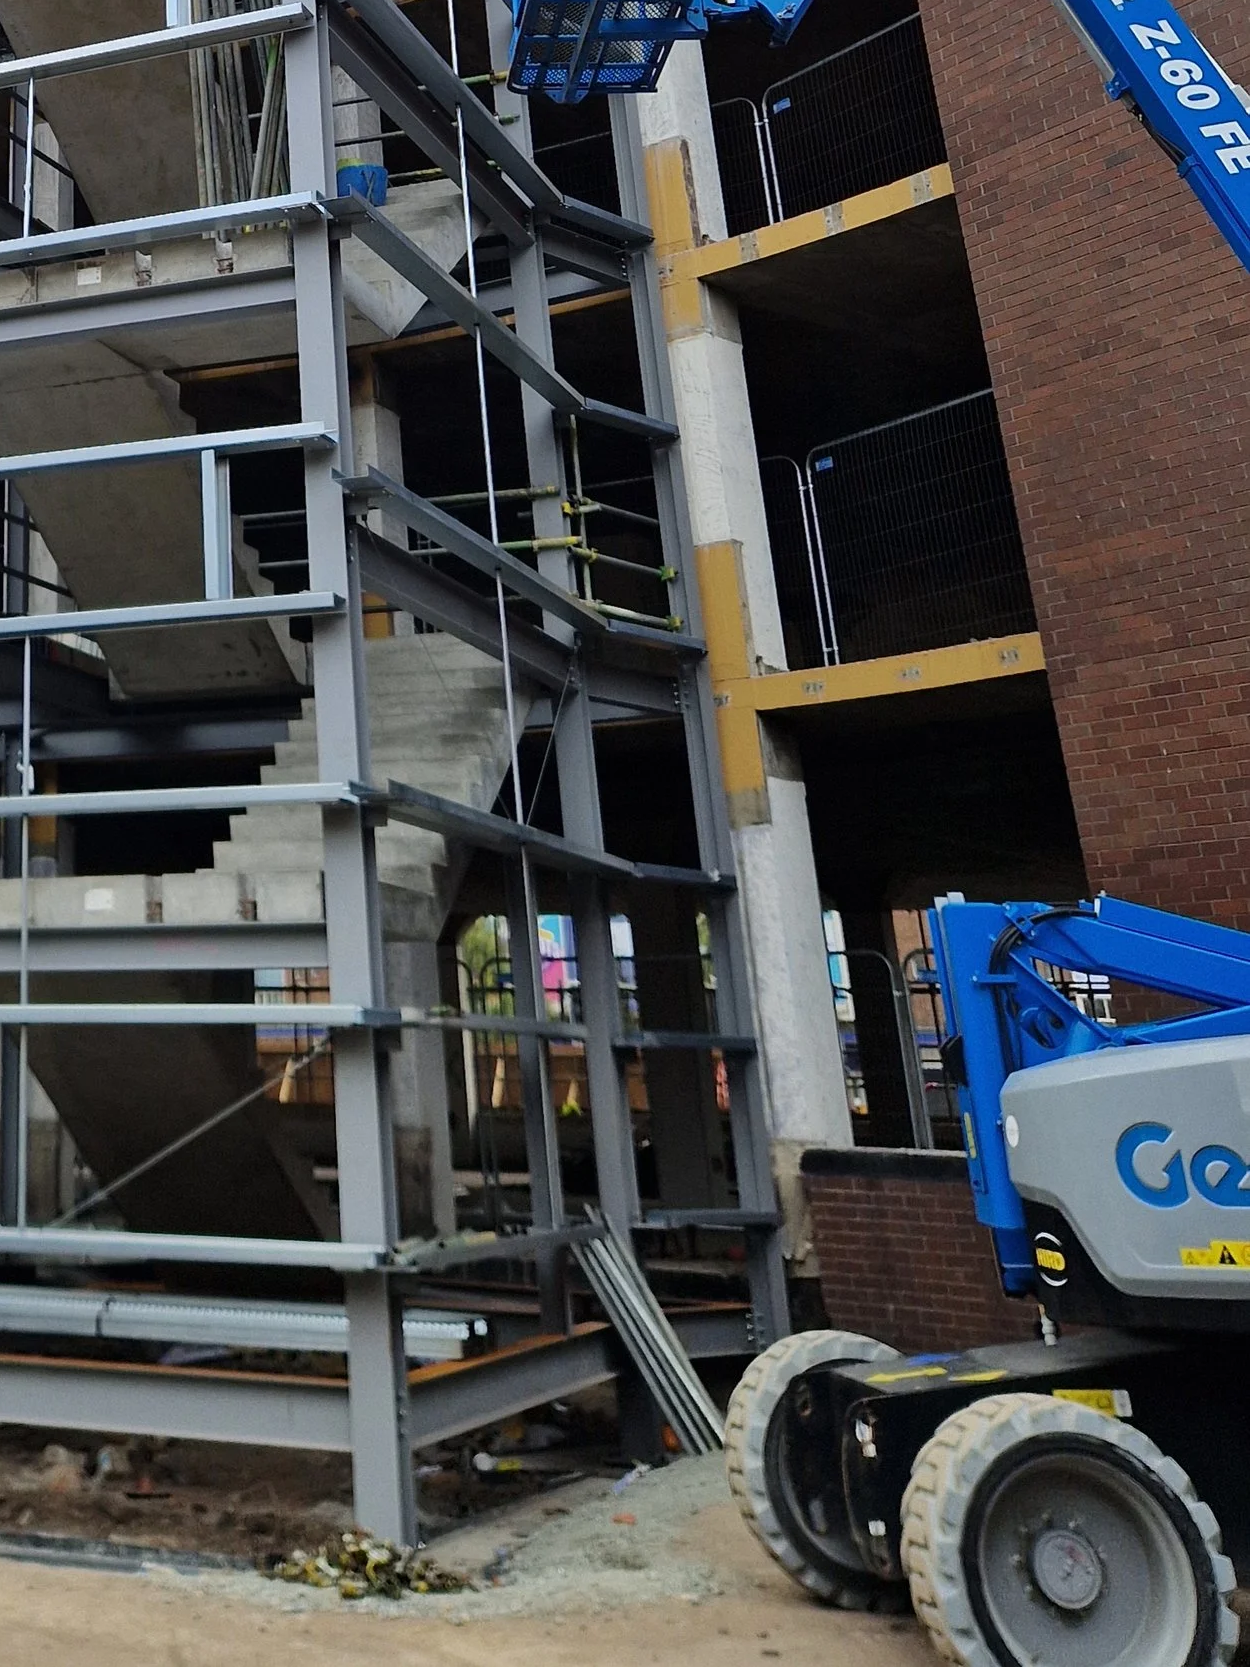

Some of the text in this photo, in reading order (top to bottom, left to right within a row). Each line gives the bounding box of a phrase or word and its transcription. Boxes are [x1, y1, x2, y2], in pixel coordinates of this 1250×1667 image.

[1129, 19, 1220, 110] Z-60
[1199, 121, 1250, 174] FE
[1115, 1121, 1250, 1210] Ge
